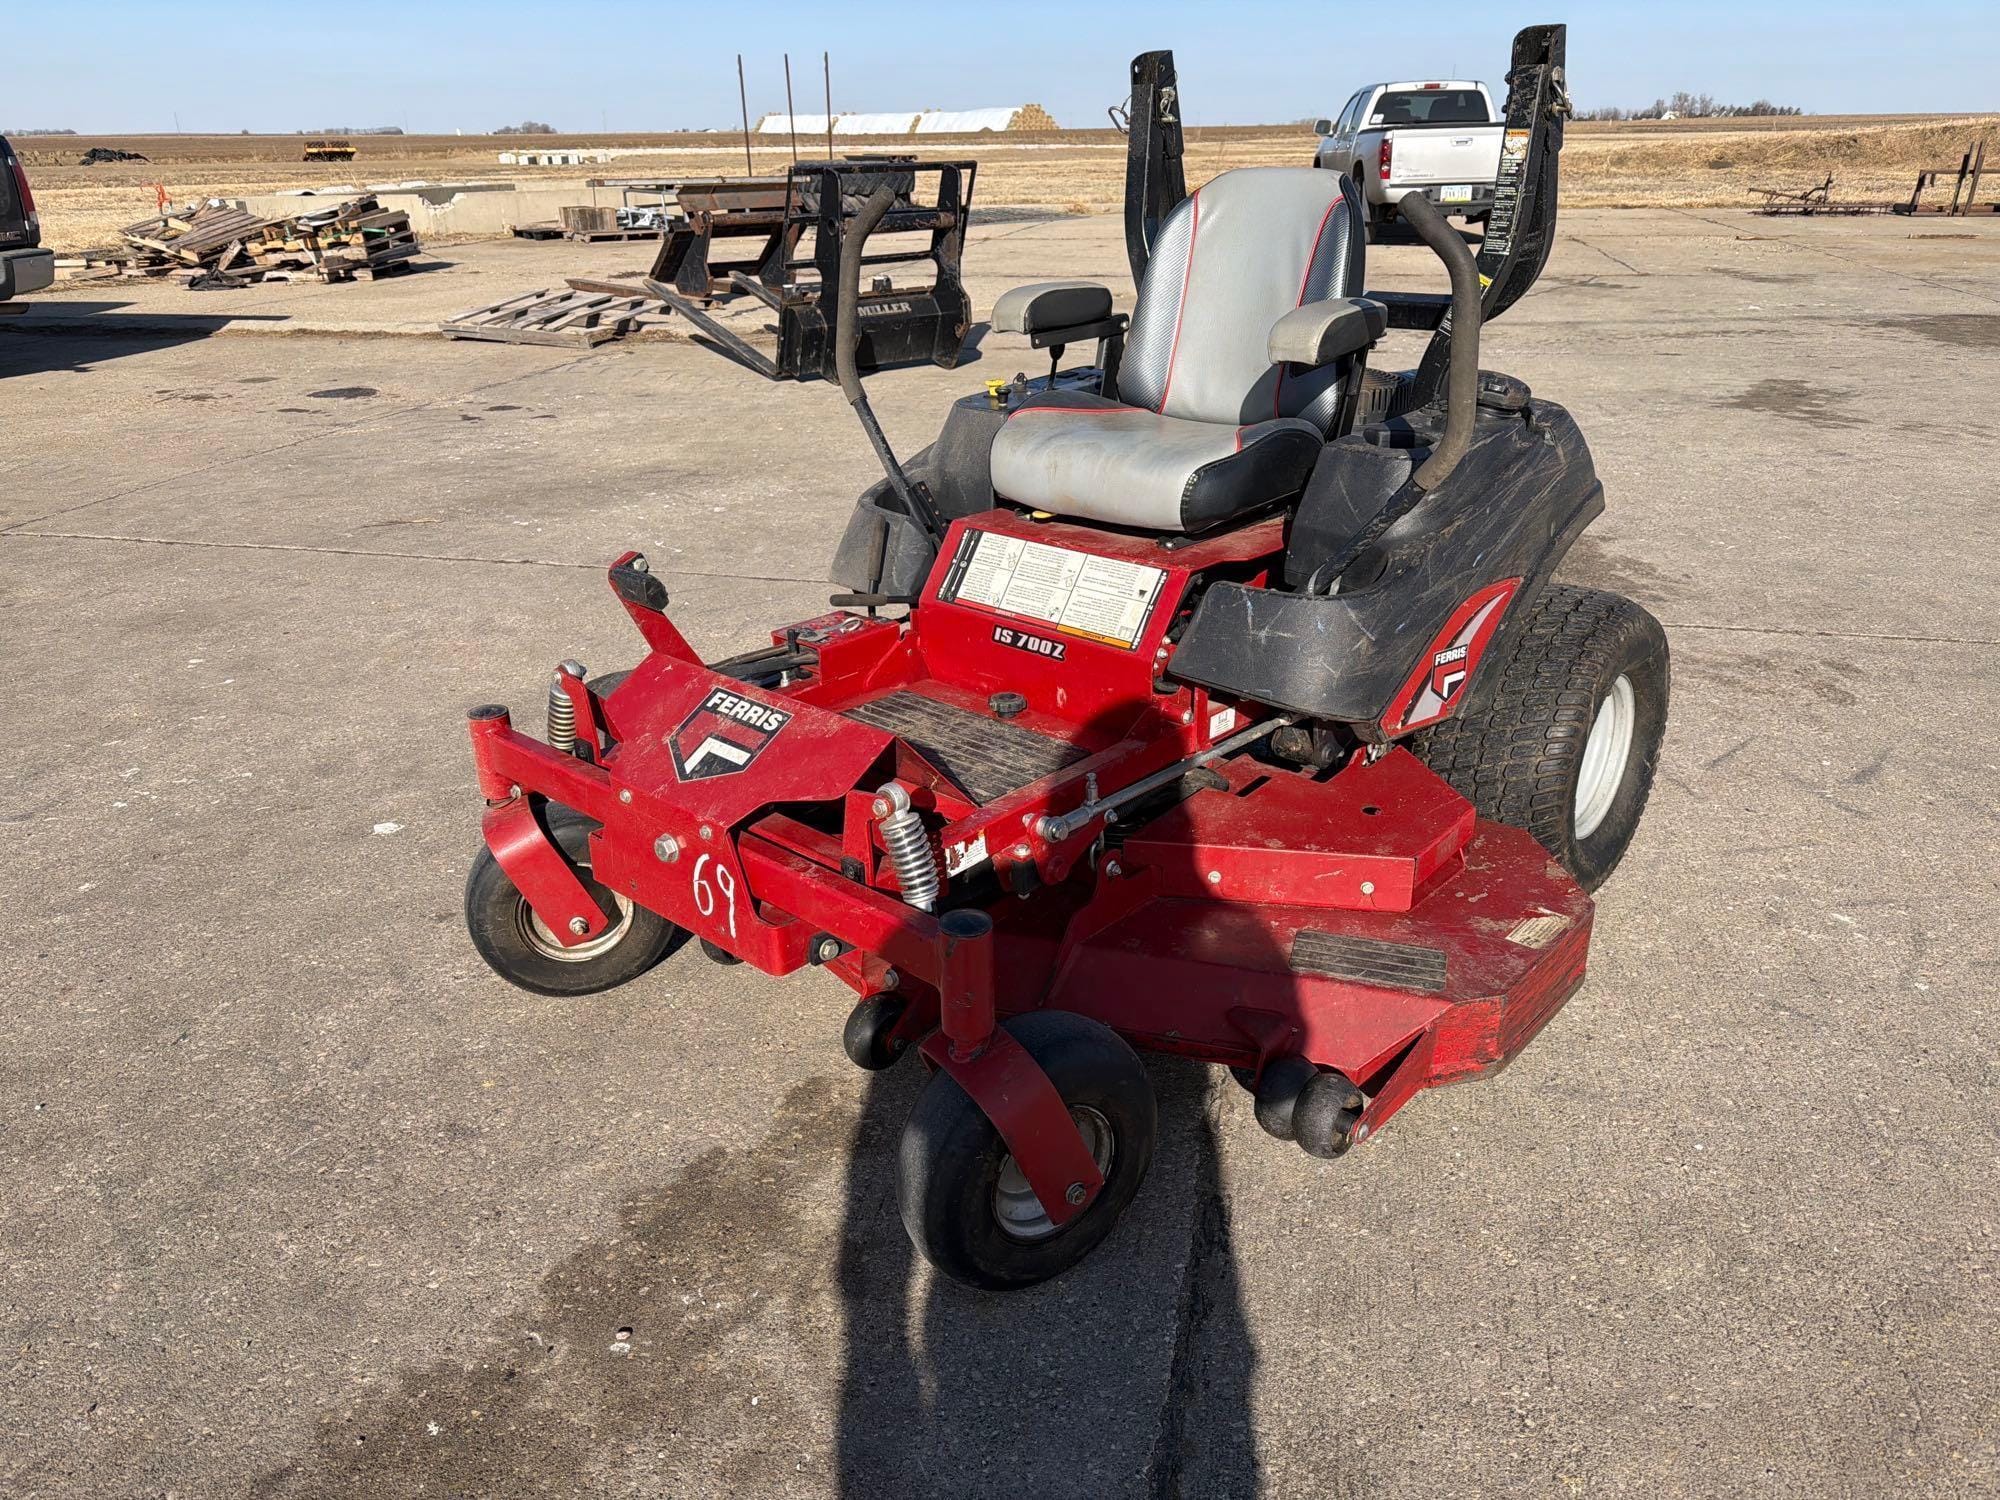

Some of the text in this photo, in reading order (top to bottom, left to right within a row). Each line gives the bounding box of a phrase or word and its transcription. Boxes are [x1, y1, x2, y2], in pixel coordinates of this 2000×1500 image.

[857, 302, 912, 317] MILLER
[994, 627, 1065, 658] IS 700Z
[1435, 647, 1467, 666] FERRIS
[706, 692, 784, 731] FERRIS
[693, 853, 737, 939] 69
